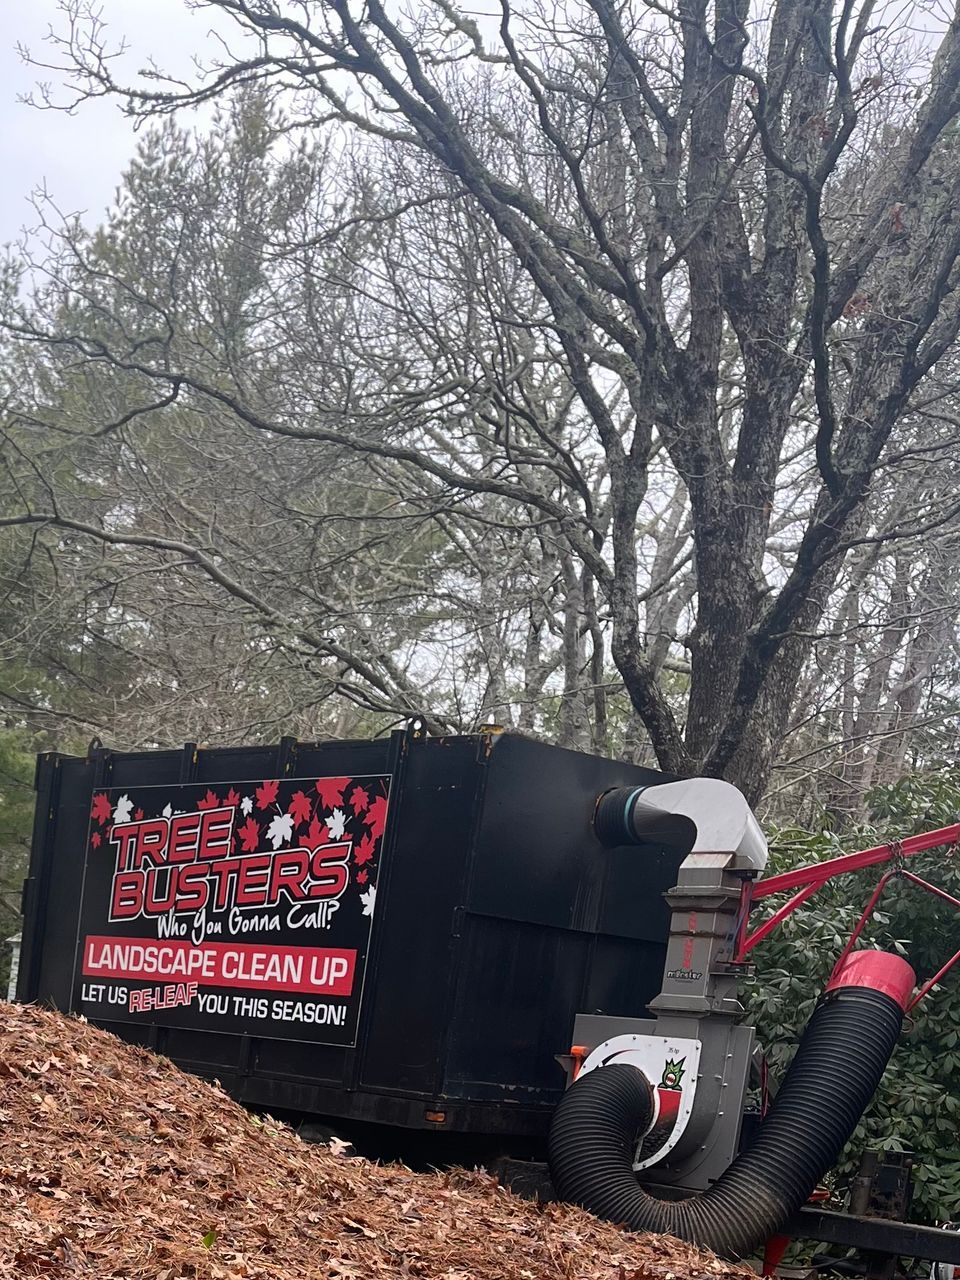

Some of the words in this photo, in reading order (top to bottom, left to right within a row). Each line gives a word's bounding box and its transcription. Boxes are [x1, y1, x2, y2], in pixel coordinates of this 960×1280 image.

[109, 806, 235, 873] TREE
[108, 841, 352, 923] BUSTERS
[157, 907, 187, 939] Who
[191, 908, 222, 946] You
[228, 907, 281, 935] Gonna
[286, 900, 340, 930] Call?
[87, 943, 217, 977] LANDSCAPE
[221, 951, 304, 984] CLEAN
[309, 956, 348, 986] UP
[81, 983, 106, 1003] LET
[107, 985, 128, 1005] US
[128, 981, 199, 1013] RE-LEAF
[198, 993, 230, 1014] YOU
[232, 996, 269, 1018] THIS
[271, 999, 348, 1026] SEASON!
